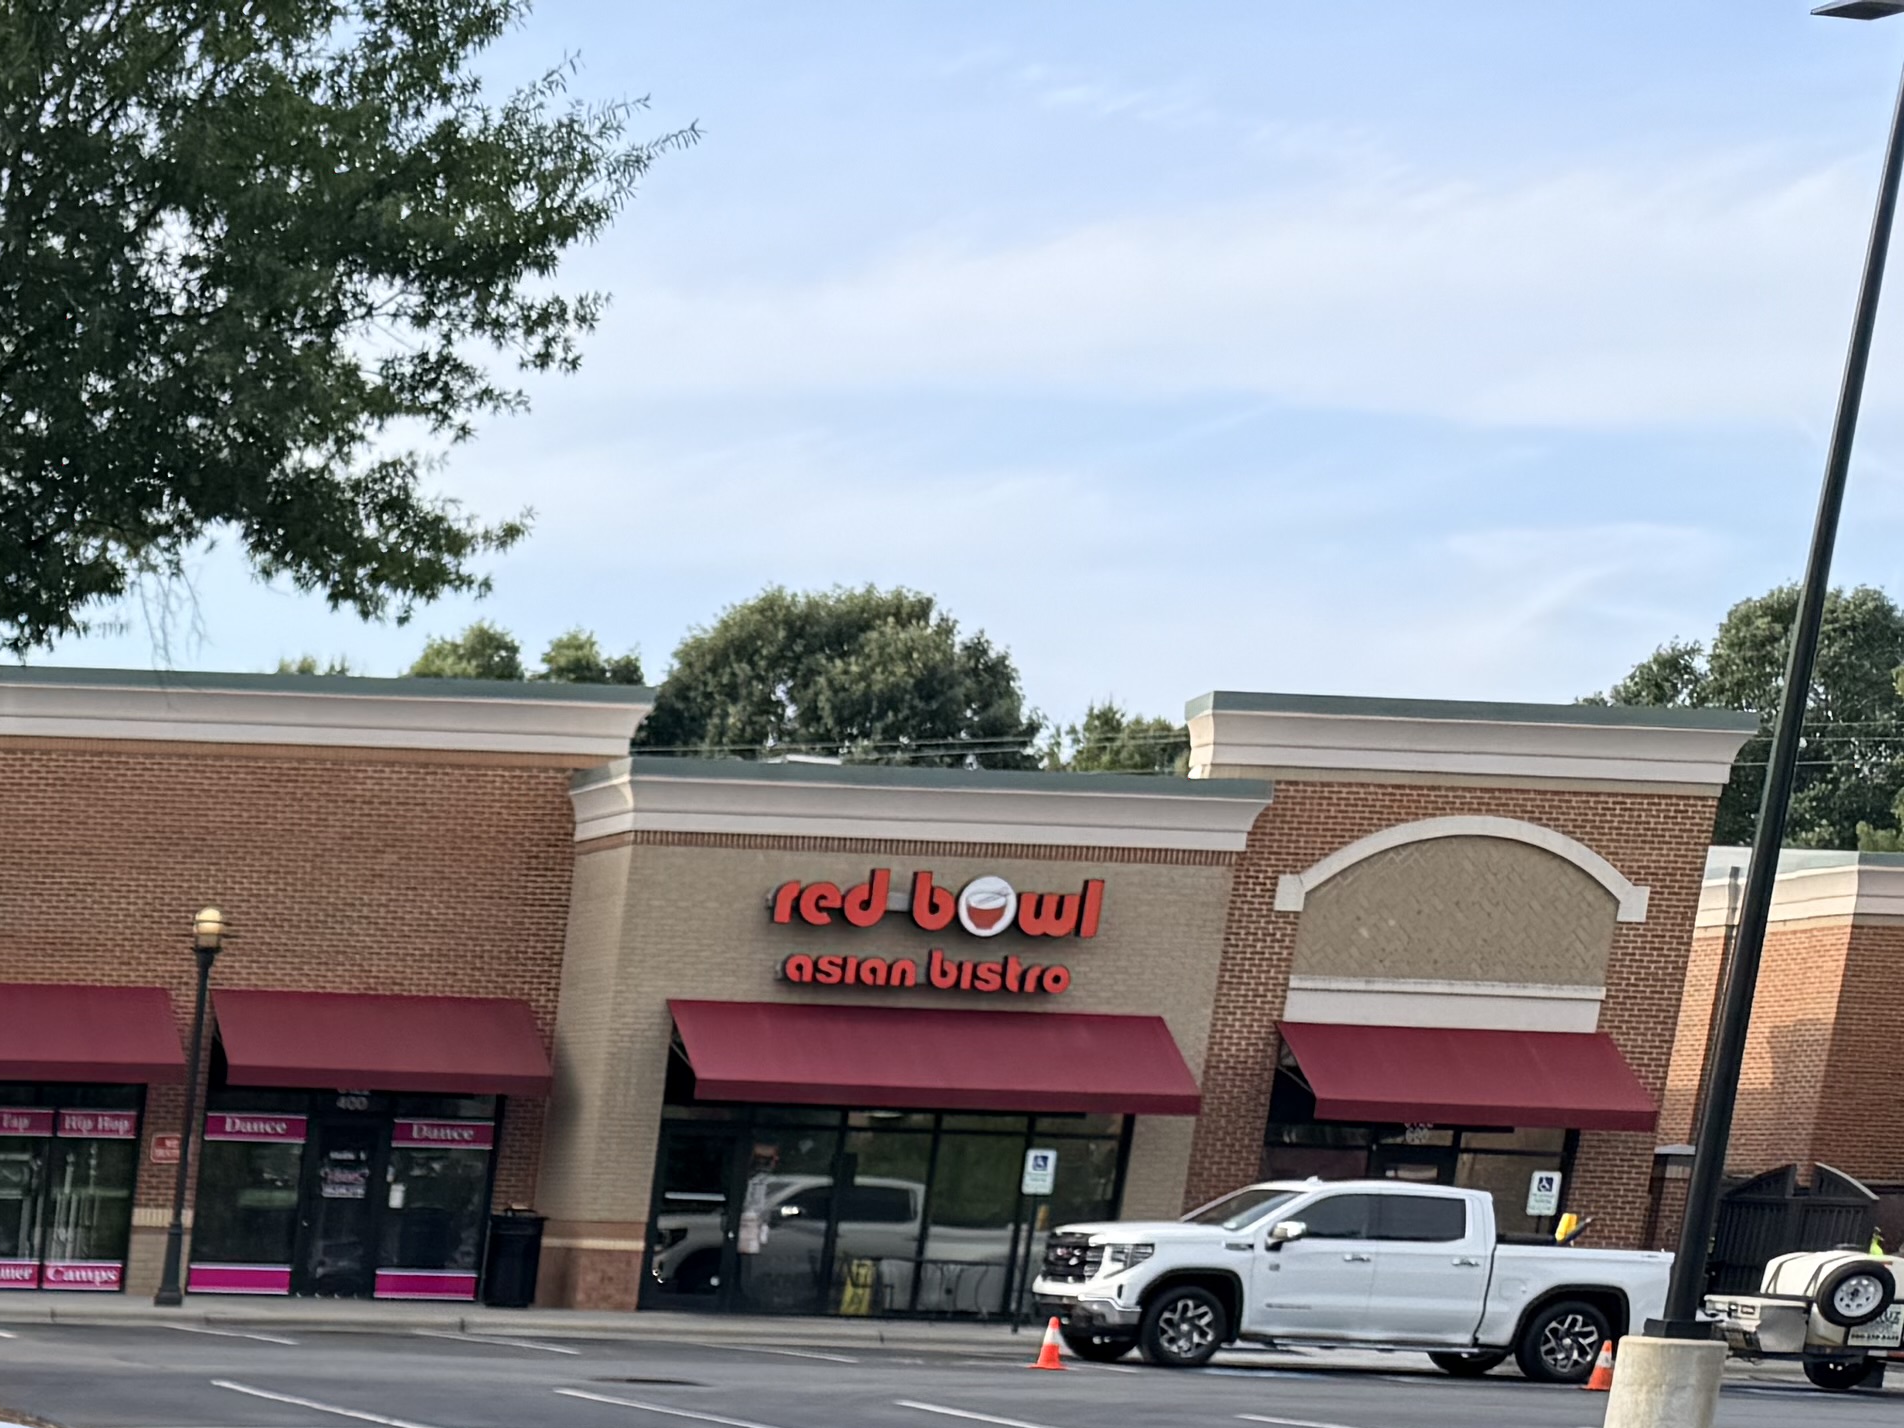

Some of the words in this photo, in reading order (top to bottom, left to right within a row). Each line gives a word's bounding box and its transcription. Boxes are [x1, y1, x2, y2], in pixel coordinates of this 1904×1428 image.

[774, 868, 890, 927] red
[913, 871, 1105, 938] bowl
[785, 954, 917, 987] asian
[930, 949, 1071, 994] bistro
[336, 1096, 369, 1111] 400
[2, 1114, 30, 1131] Tap
[64, 1116, 93, 1134] Hip
[97, 1116, 130, 1135] Hop
[224, 1117, 288, 1134] Dance
[411, 1125, 474, 1141] Dance
[47, 1265, 120, 1286] Camps
